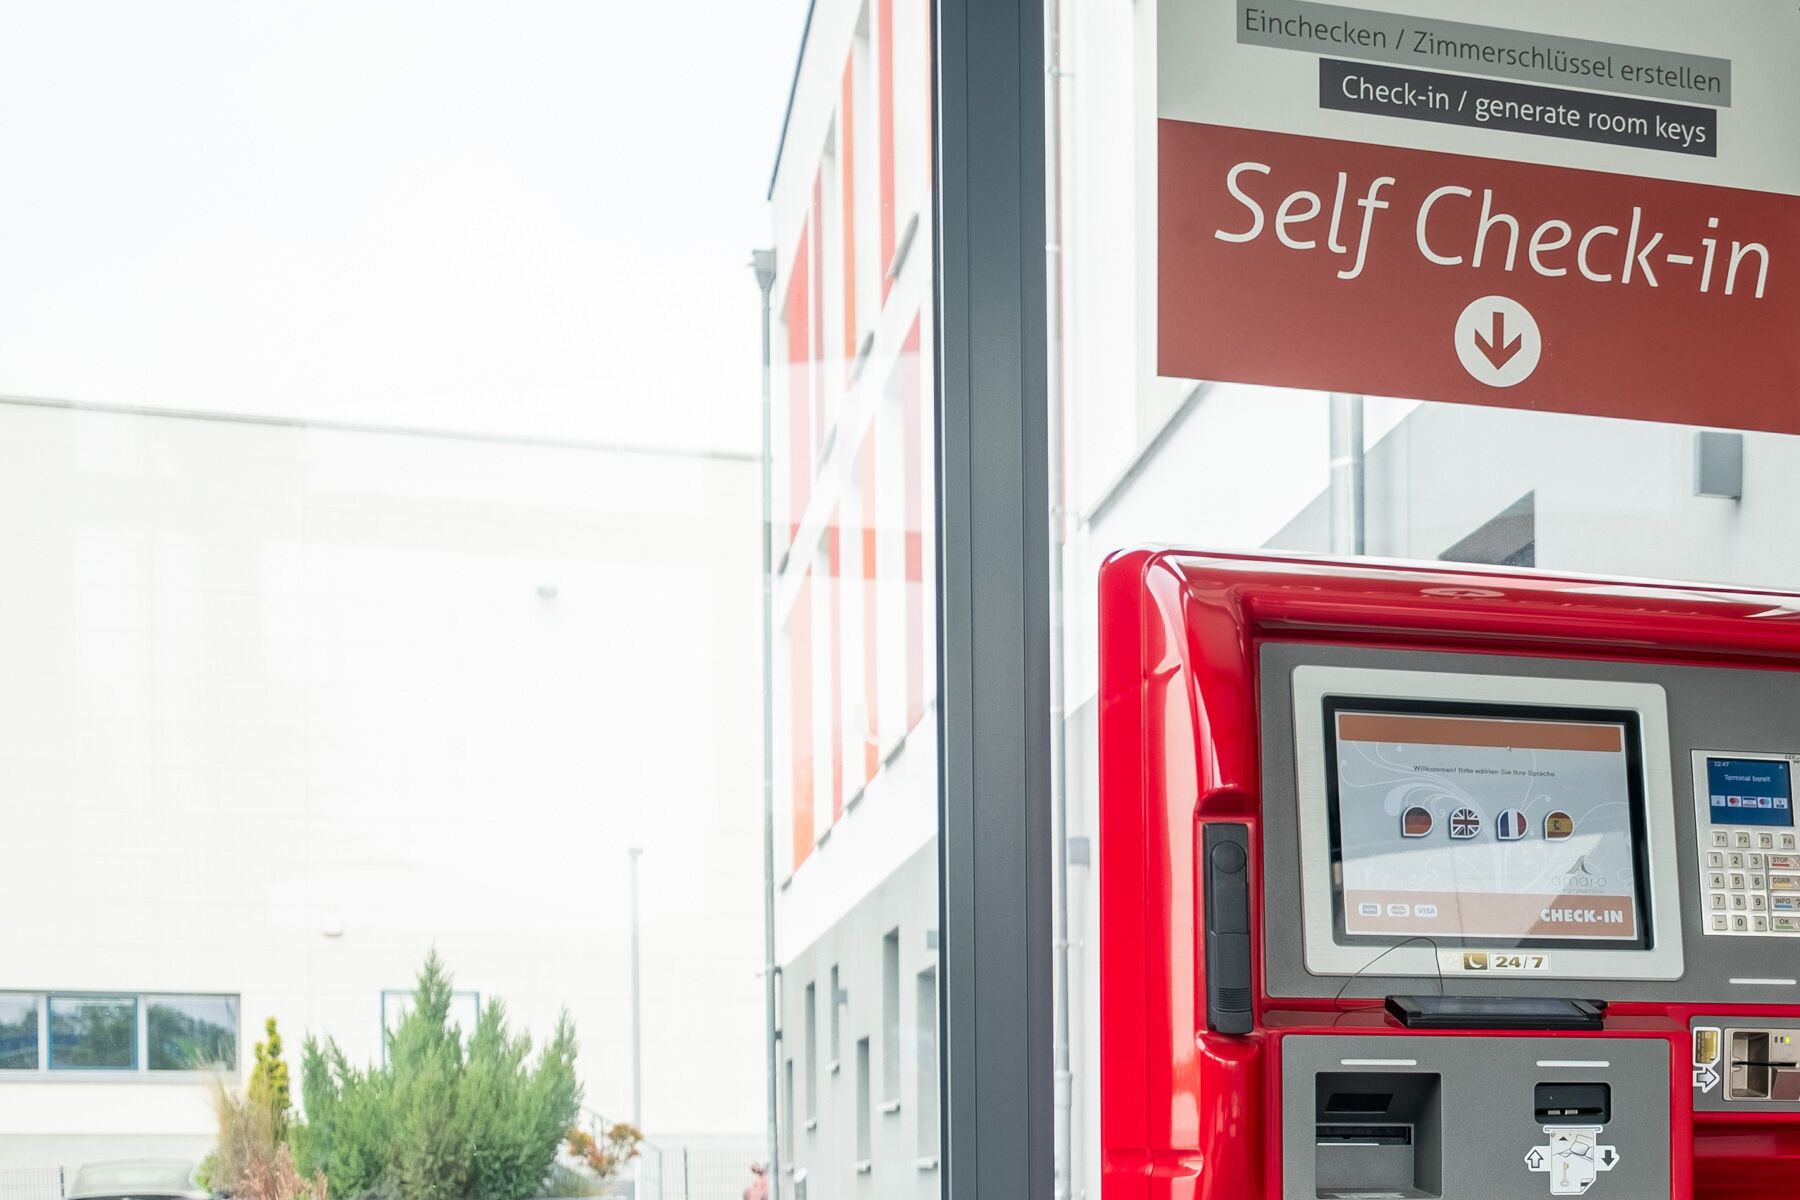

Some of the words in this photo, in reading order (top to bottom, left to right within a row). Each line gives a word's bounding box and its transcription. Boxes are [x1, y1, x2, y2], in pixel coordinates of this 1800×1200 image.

[1245, 8, 1387, 48] Einchecken
[1394, 28, 1405, 50] /
[1413, 31, 1614, 79] Zimmerschlüssel
[1620, 61, 1722, 93] erstellen
[1342, 75, 1450, 111] Check-in
[1457, 90, 1468, 113] /
[1474, 96, 1580, 128] generate
[1587, 110, 1648, 136] room
[1655, 114, 1707, 144] keys
[1214, 161, 1396, 280] Self
[1415, 184, 1770, 298] Check-in
[1724, 774, 1751, 782] Terminal
[1551, 875, 1607, 889] amaro
[1418, 907, 1436, 915] VISA
[1540, 908, 1624, 924] CHECK-IN
[1494, 955, 1544, 970] 24/7
